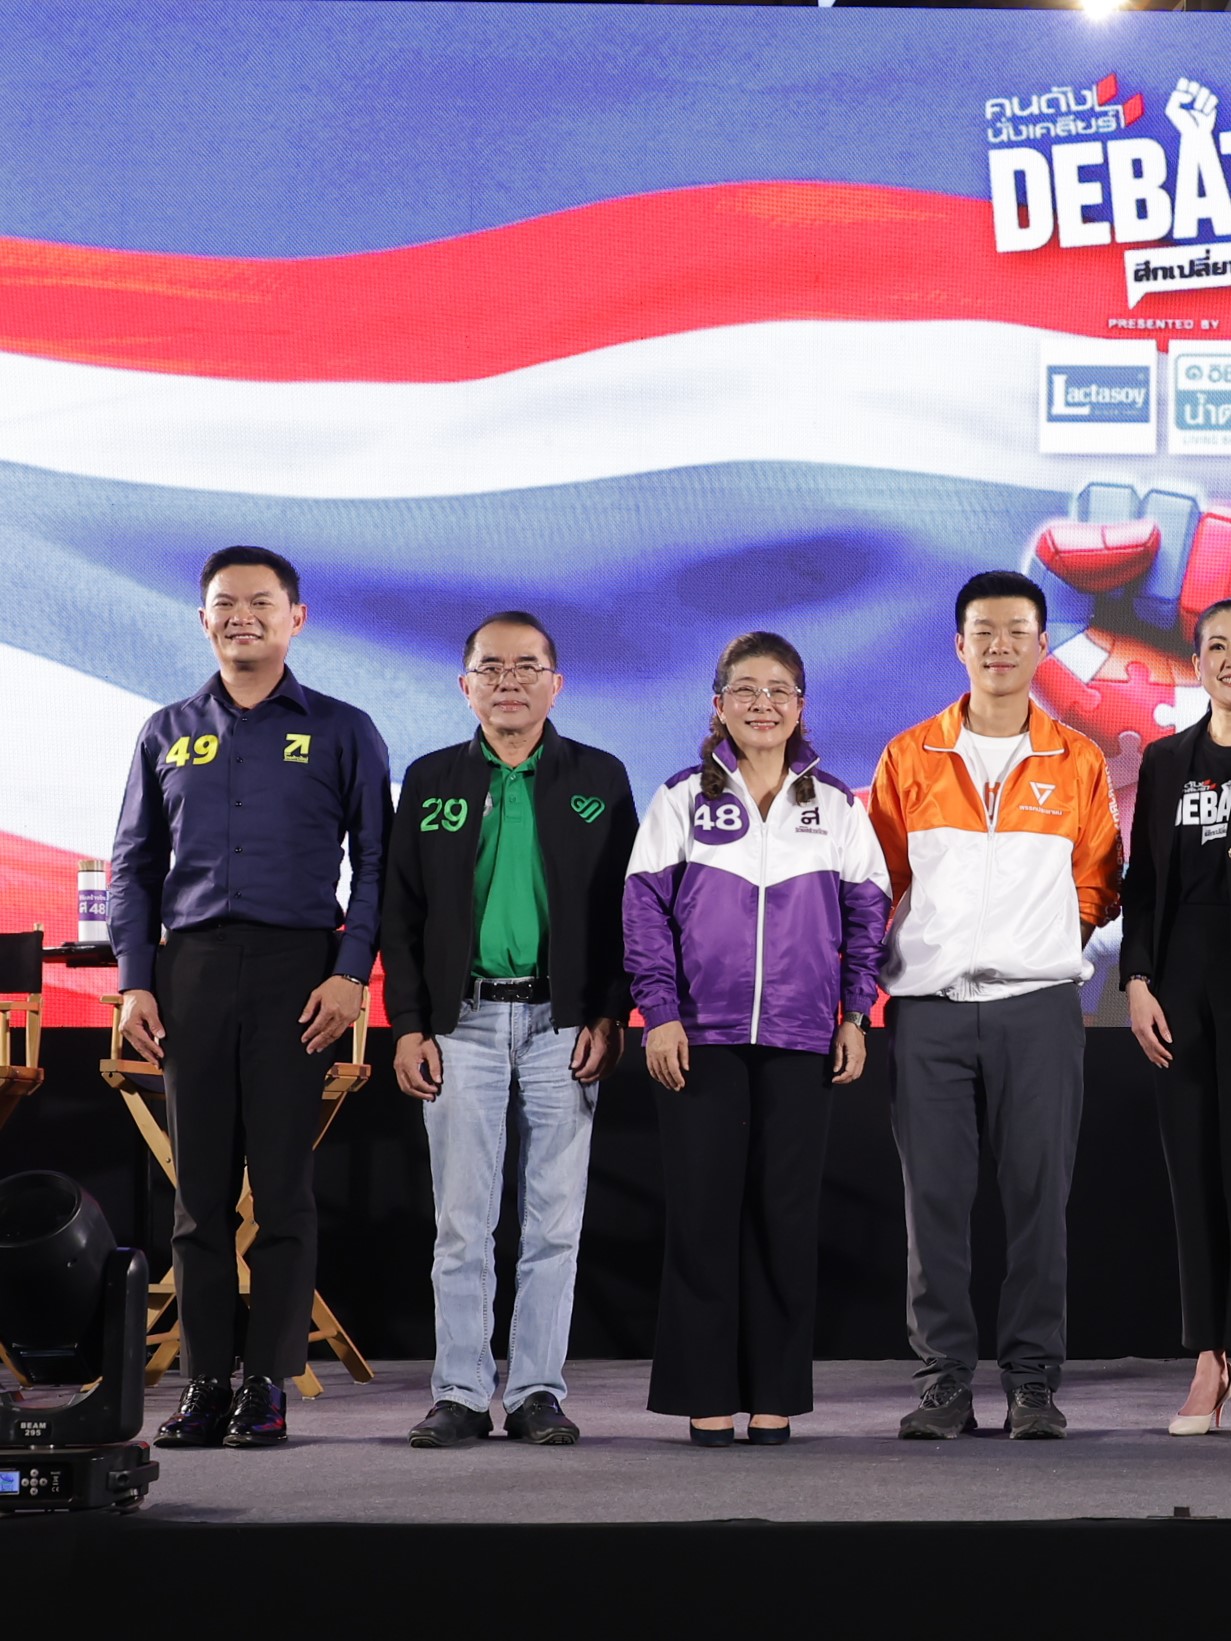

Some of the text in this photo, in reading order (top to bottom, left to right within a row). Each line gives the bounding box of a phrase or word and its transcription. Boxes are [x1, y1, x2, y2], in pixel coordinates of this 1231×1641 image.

[1108, 319, 1220, 330] PRESENTED BY
[1051, 373, 1146, 416] Lactasoy
[165, 733, 219, 768] 49
[420, 797, 468, 832] 29
[694, 803, 743, 831] 48
[89, 902, 106, 915] 48
[20, 1422, 47, 1430] BEAM
[24, 1429, 42, 1437] 295
